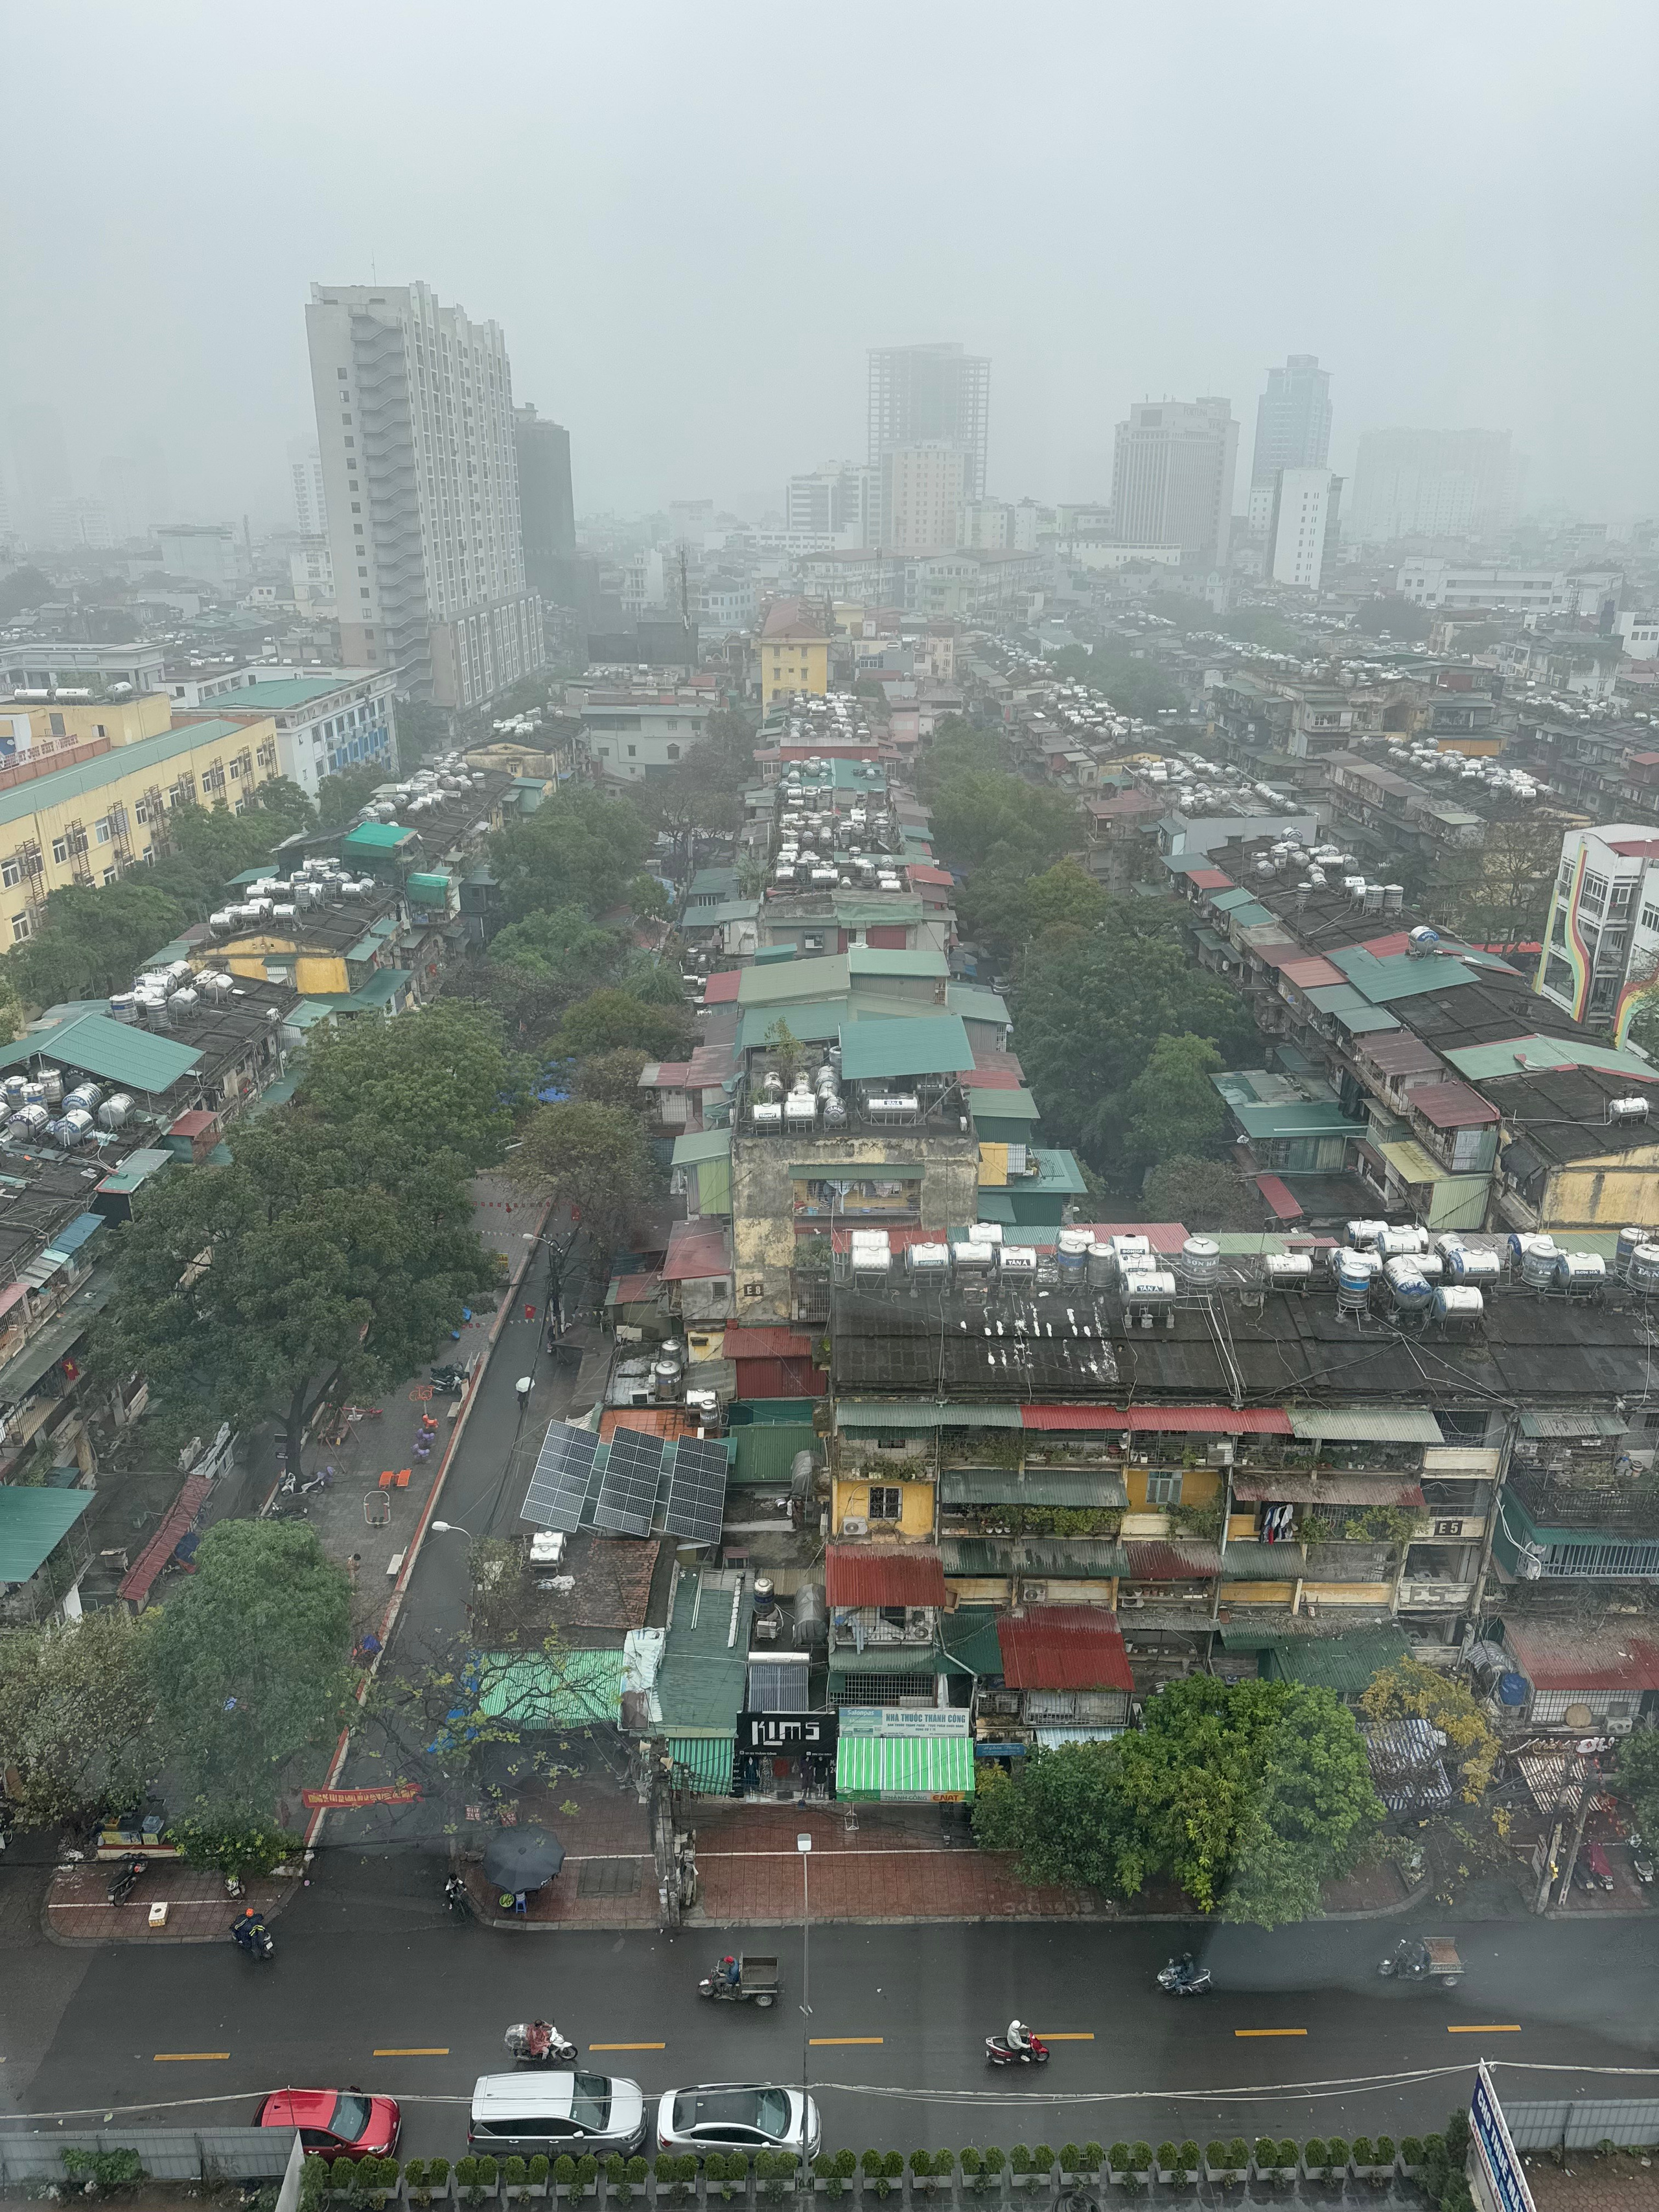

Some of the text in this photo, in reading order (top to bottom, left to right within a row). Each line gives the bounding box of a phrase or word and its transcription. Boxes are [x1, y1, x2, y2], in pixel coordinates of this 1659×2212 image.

[886, 1712, 899, 1722] NHÀ
[901, 1711, 923, 1723] THUỐC
[925, 1713, 946, 1723] THÀNH
[1478, 2088, 1492, 2131] CHO
[1491, 2125, 1509, 2182] THUÊ
